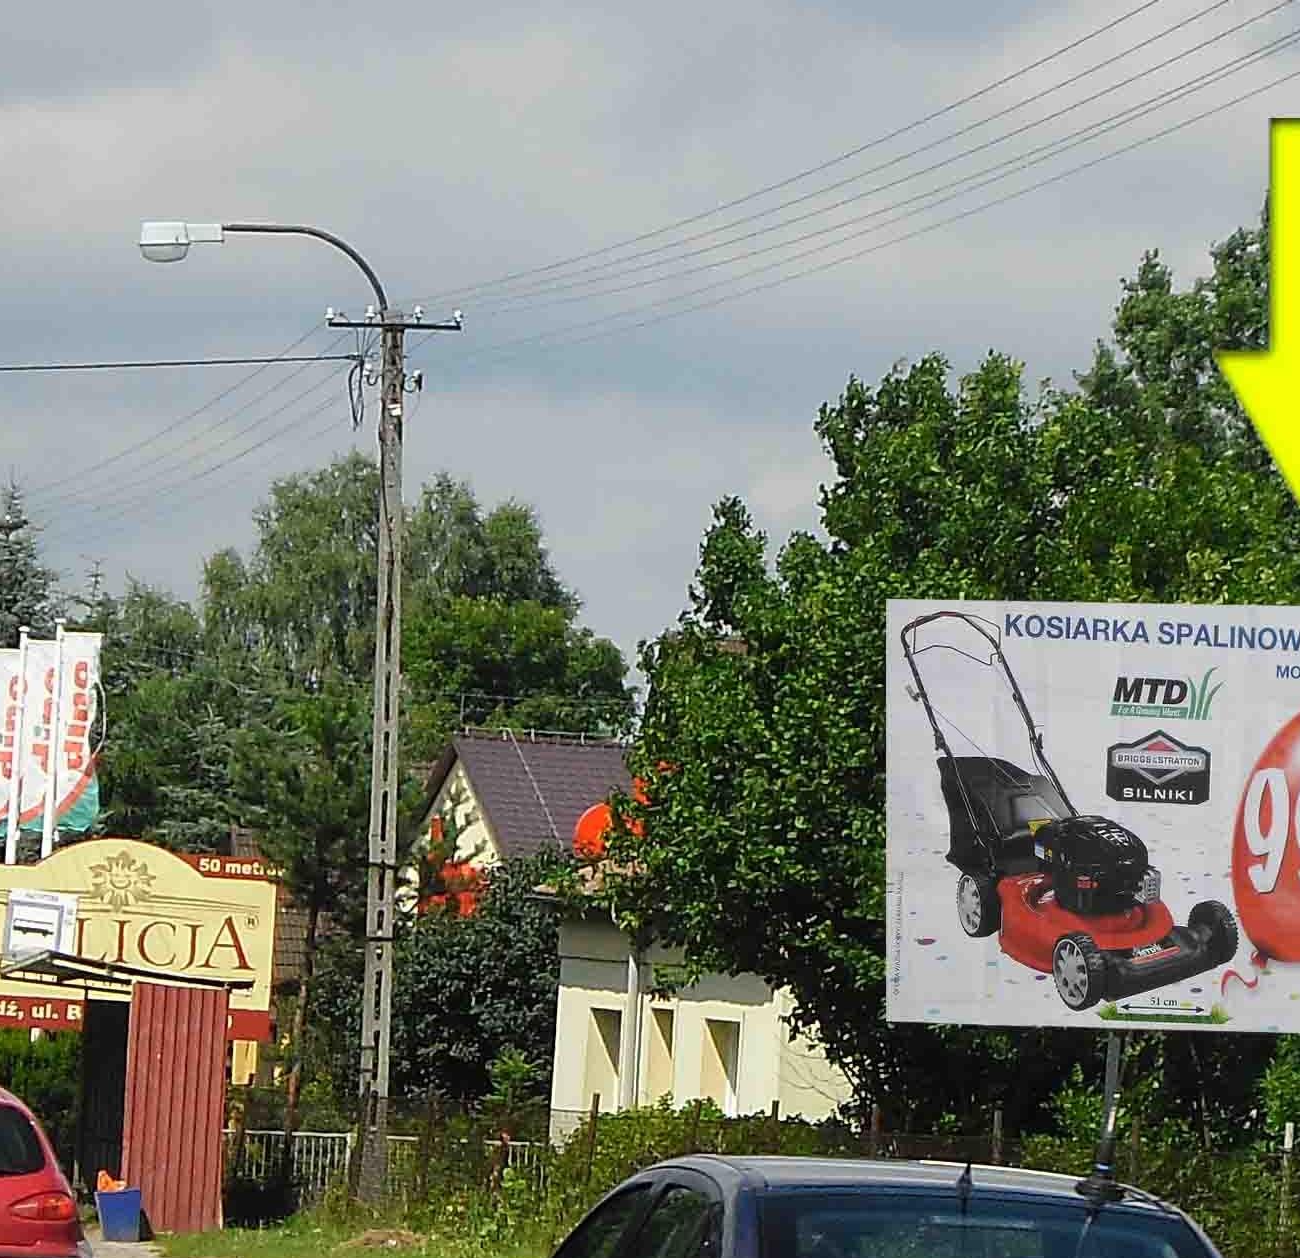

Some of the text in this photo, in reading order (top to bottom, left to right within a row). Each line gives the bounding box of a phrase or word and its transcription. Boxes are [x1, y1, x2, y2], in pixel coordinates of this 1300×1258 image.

[1005, 614, 1149, 644] KOSIARKA
[1113, 677, 1188, 705] MTD
[1123, 787, 1193, 801] SILNIKI
[199, 857, 221, 872] 50
[1149, 997, 1178, 1007] 51 cm
[31, 1003, 60, 1019] ul.
